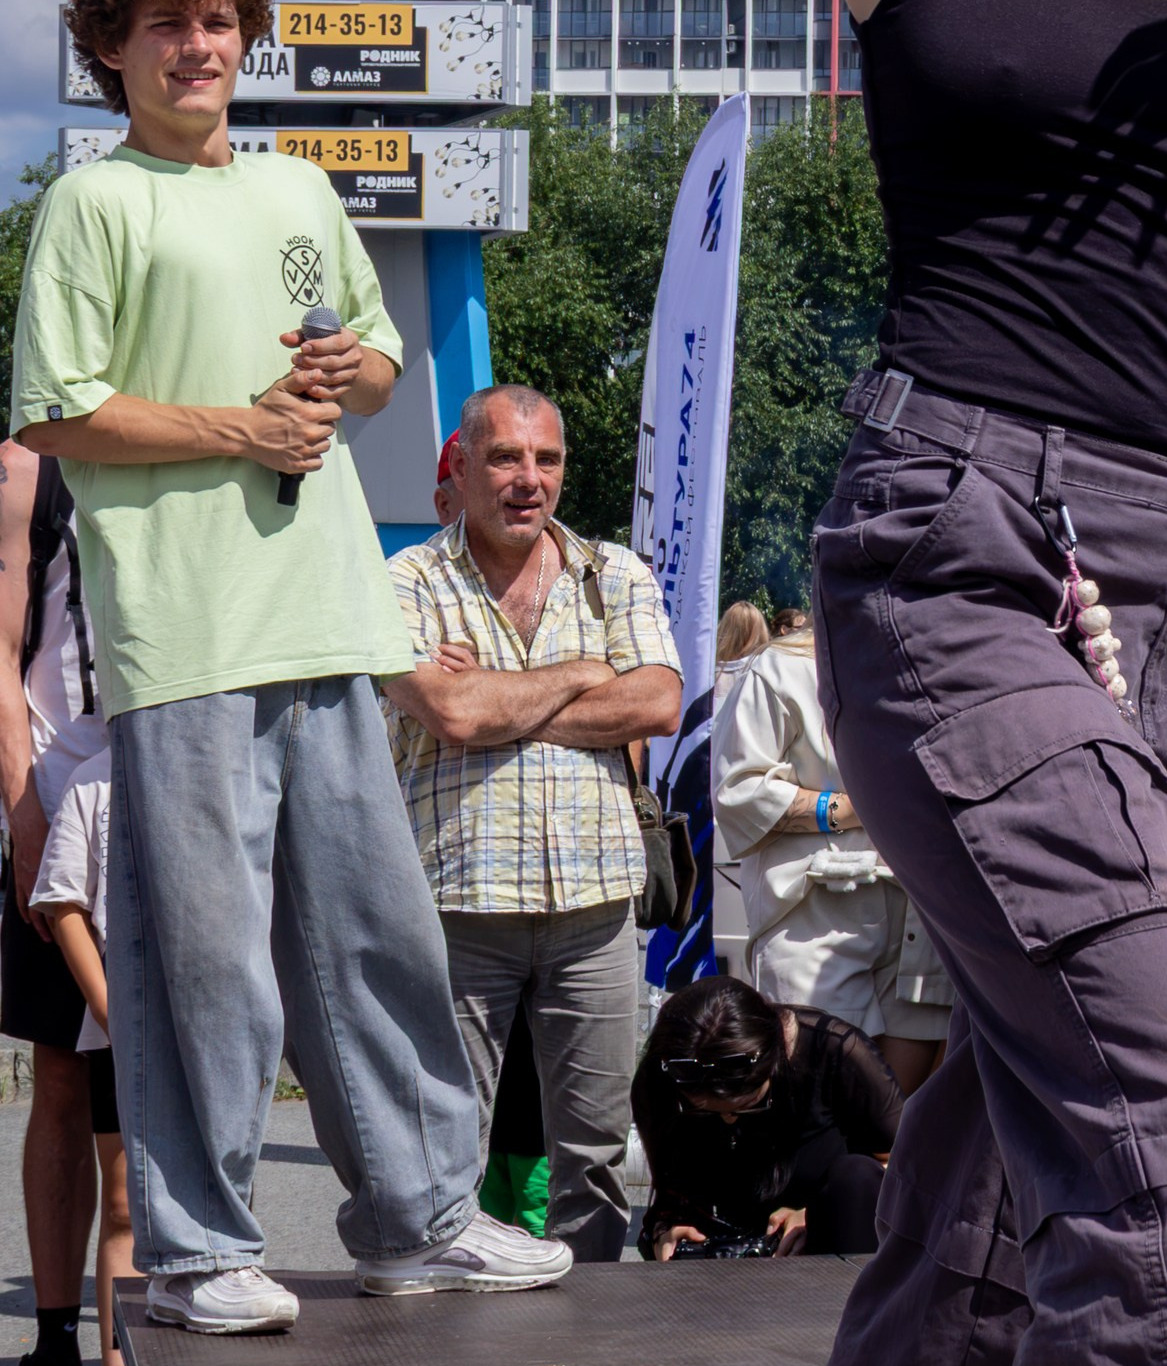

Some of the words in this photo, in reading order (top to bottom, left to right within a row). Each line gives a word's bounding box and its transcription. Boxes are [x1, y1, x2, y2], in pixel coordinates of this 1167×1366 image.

[289, 13, 403, 36] 214-35-13
[360, 49, 421, 63] РОДНИК
[332, 70, 381, 83] АЛМАЗ
[285, 139, 399, 163] 214-35-13
[356, 175, 417, 189] РОДНИК
[340, 196, 377, 209] ЛМАЗ
[285, 235, 315, 247] HOOK
[301, 250, 310, 266] S
[662, 328, 696, 619] ЛЬТУРА74
